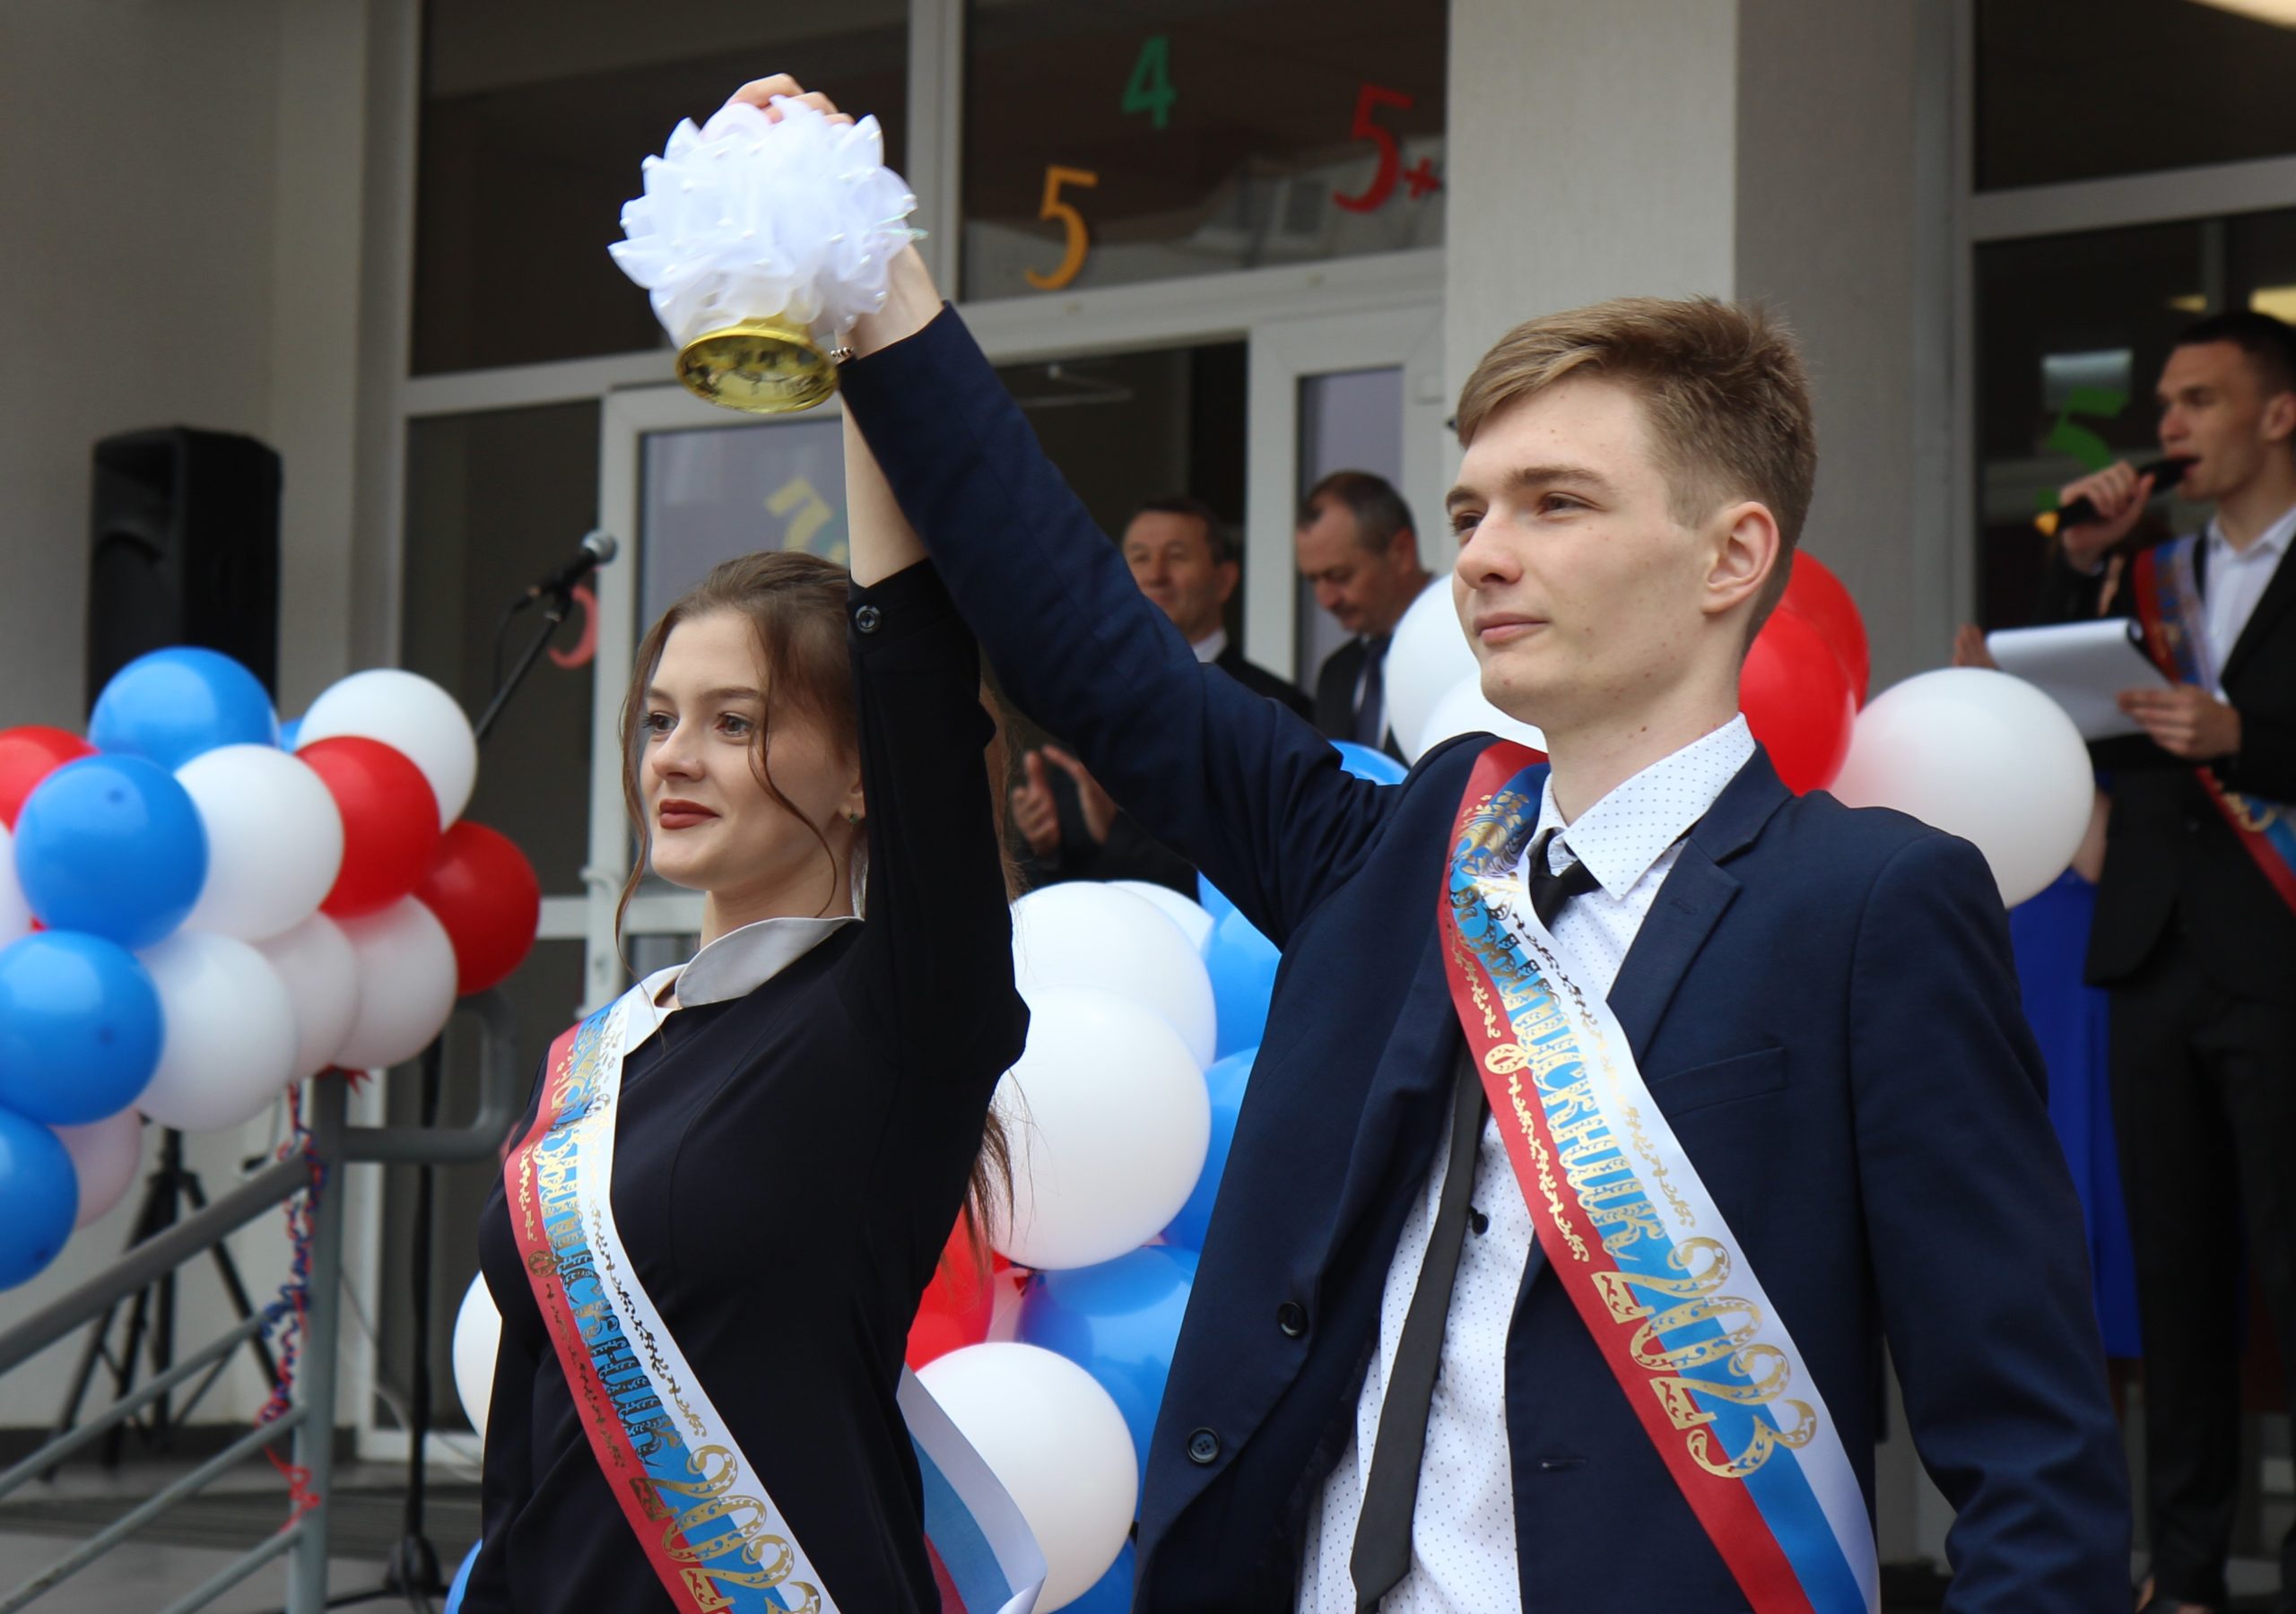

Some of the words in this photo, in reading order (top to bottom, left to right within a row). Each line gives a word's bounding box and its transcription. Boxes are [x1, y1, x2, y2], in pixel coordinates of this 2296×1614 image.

[1122, 36, 1177, 127] 4
[1025, 165, 1098, 290] 5
[1449, 872, 1668, 1261] Выпускник
[1591, 1237, 1817, 1479] 2023
